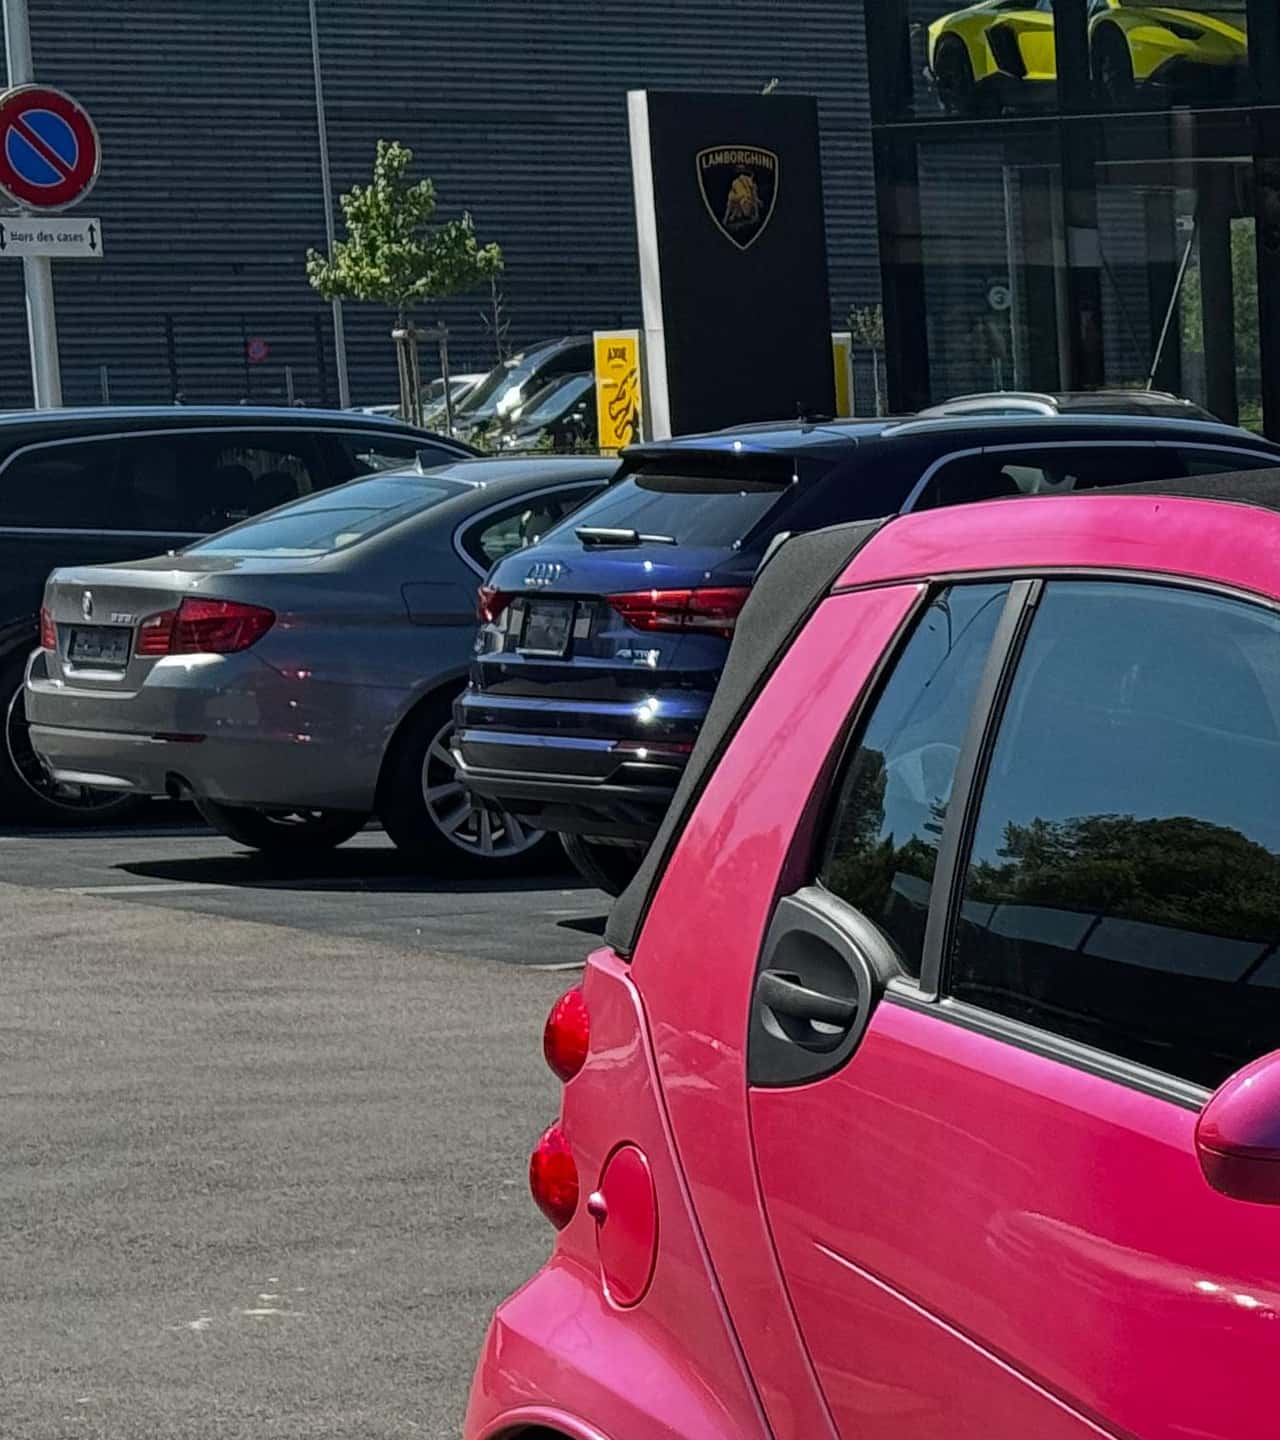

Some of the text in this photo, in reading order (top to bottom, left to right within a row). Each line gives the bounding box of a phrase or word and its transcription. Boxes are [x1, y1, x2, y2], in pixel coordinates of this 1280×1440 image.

[702, 151, 773, 169] LAMBORGHINI
[10, 231, 84, 243] Hors des cases
